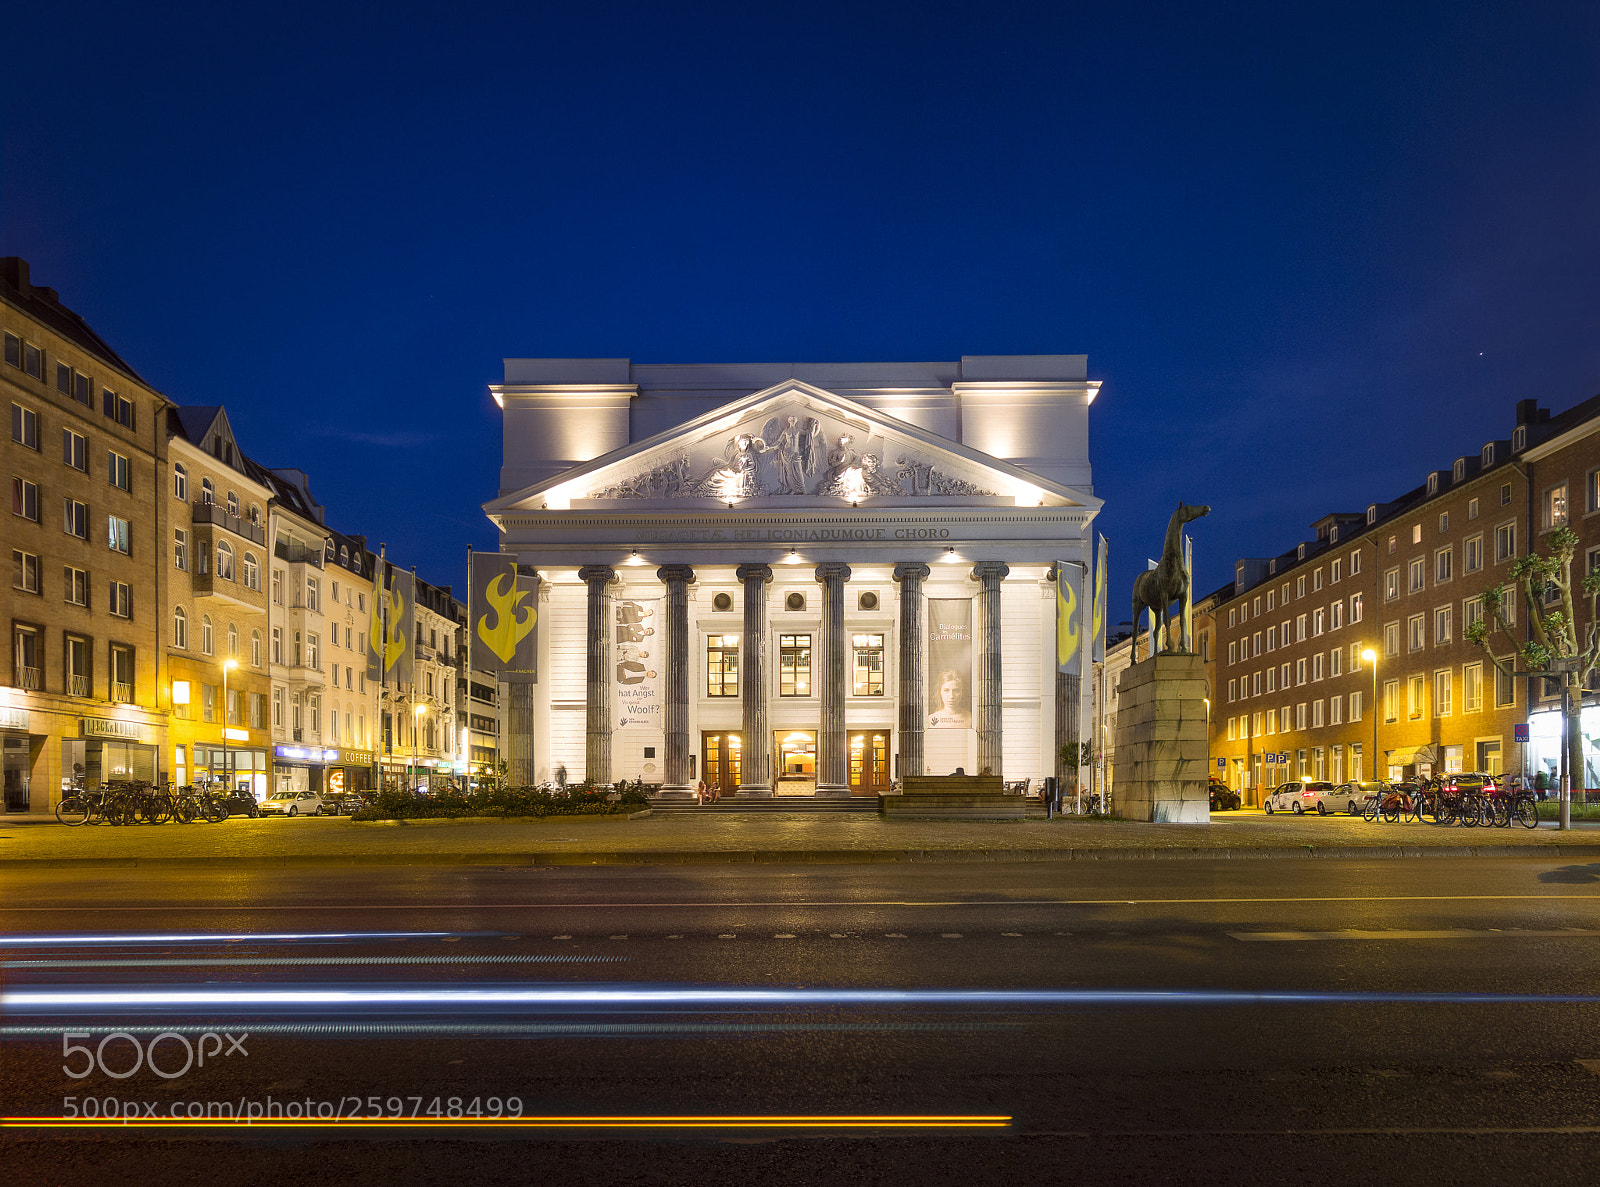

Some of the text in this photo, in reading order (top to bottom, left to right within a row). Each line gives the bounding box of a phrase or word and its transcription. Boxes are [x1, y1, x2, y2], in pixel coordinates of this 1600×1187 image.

[734, 528, 886, 541] HELICONIADUMQUE
[894, 528, 950, 540] CHORO
[632, 690, 655, 698] Angst
[627, 705, 660, 714] Woolf?
[345, 751, 372, 764] COFFEE
